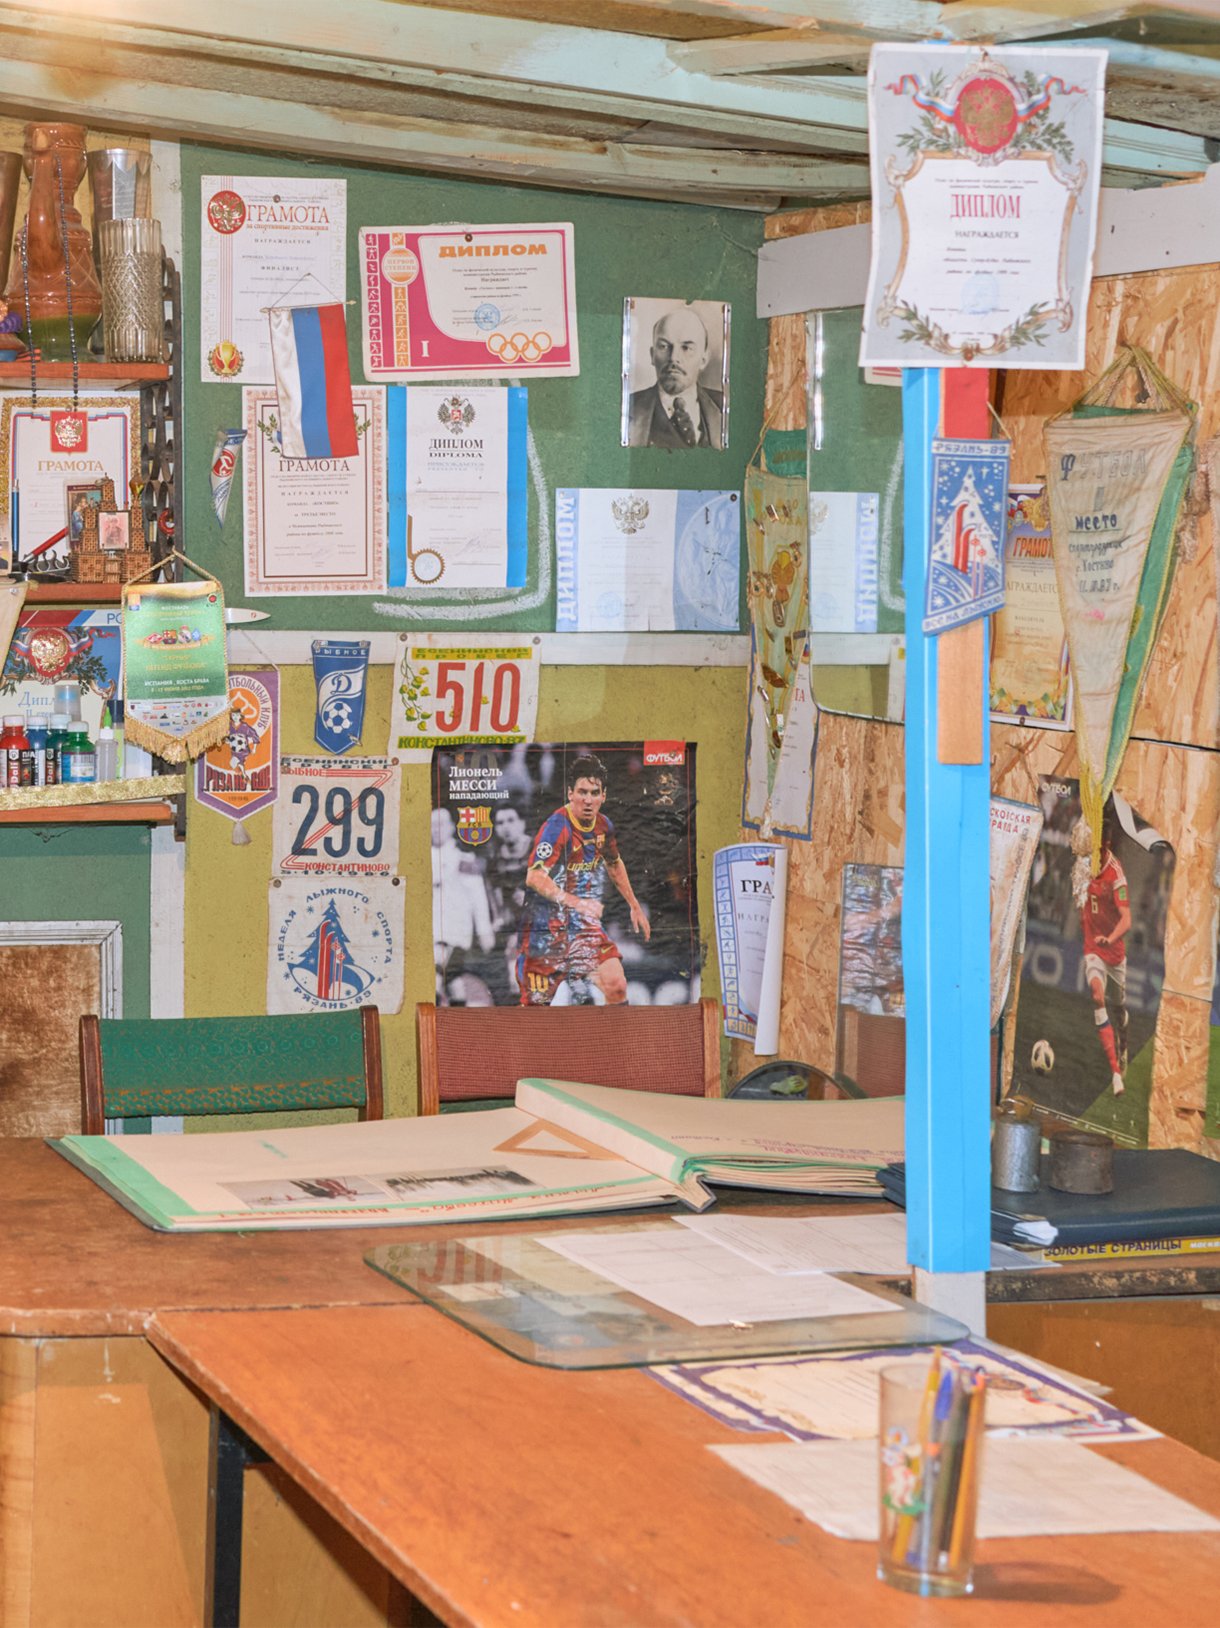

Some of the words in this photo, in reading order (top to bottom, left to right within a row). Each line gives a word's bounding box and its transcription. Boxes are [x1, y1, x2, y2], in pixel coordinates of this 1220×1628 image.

[246, 204, 330, 223] ГРАМОТА
[949, 193, 1021, 220] ДИПЛОМ
[955, 230, 1019, 239] НАГРАЖДАЕТСЯ
[438, 243, 548, 258] ДИПЛОМ
[421, 340, 430, 357] I
[428, 438, 484, 450] ДИПЛОМ
[37, 460, 104, 471] ГРАМОТА
[278, 459, 350, 472] ГРАМОТА
[1060, 447, 1147, 482] ФУТБОЛ
[1013, 536, 1055, 559] ГРАМО
[557, 496, 577, 622] ДИПЛОМ
[857, 501, 877, 623] ДИПЛОМ
[1006, 581, 1058, 594] АГРАЖДАЕТС
[946, 610, 960, 625] НА
[18, 692, 55, 707] Дипл
[228, 676, 270, 707] УТБОЛЬНЫЙ
[256, 705, 270, 731] КЛУБ
[435, 662, 521, 733] 510
[280, 761, 391, 770] ПРОБЕГ
[645, 753, 683, 763] ФУТБОЛ
[205, 764, 247, 792] РЯЗАНЬ
[448, 766, 503, 778] Лионель
[448, 779, 498, 792] МЕССИ
[448, 790, 510, 801] нападающий
[291, 784, 386, 858] 299
[990, 807, 1031, 825] СКОВСКАЯ
[989, 818, 1019, 834] РАВДА
[304, 862, 390, 873] КОНСТАНТИНОВО
[740, 879, 773, 894] ГРА
[1089, 894, 1099, 914] 6
[737, 912, 770, 923] НАГРА
[277, 909, 297, 962] НЕДЕЛЯ
[305, 887, 370, 905] ЛЫЖНОГО
[376, 910, 393, 965] СПОРТА
[528, 972, 549, 993] 10
[1043, 1243, 1107, 1258] ЗОЛОТЫЕ
[1110, 1239, 1182, 1253] СТРАНИЦЫ
[1188, 1240, 1220, 1249] МОСКВ
